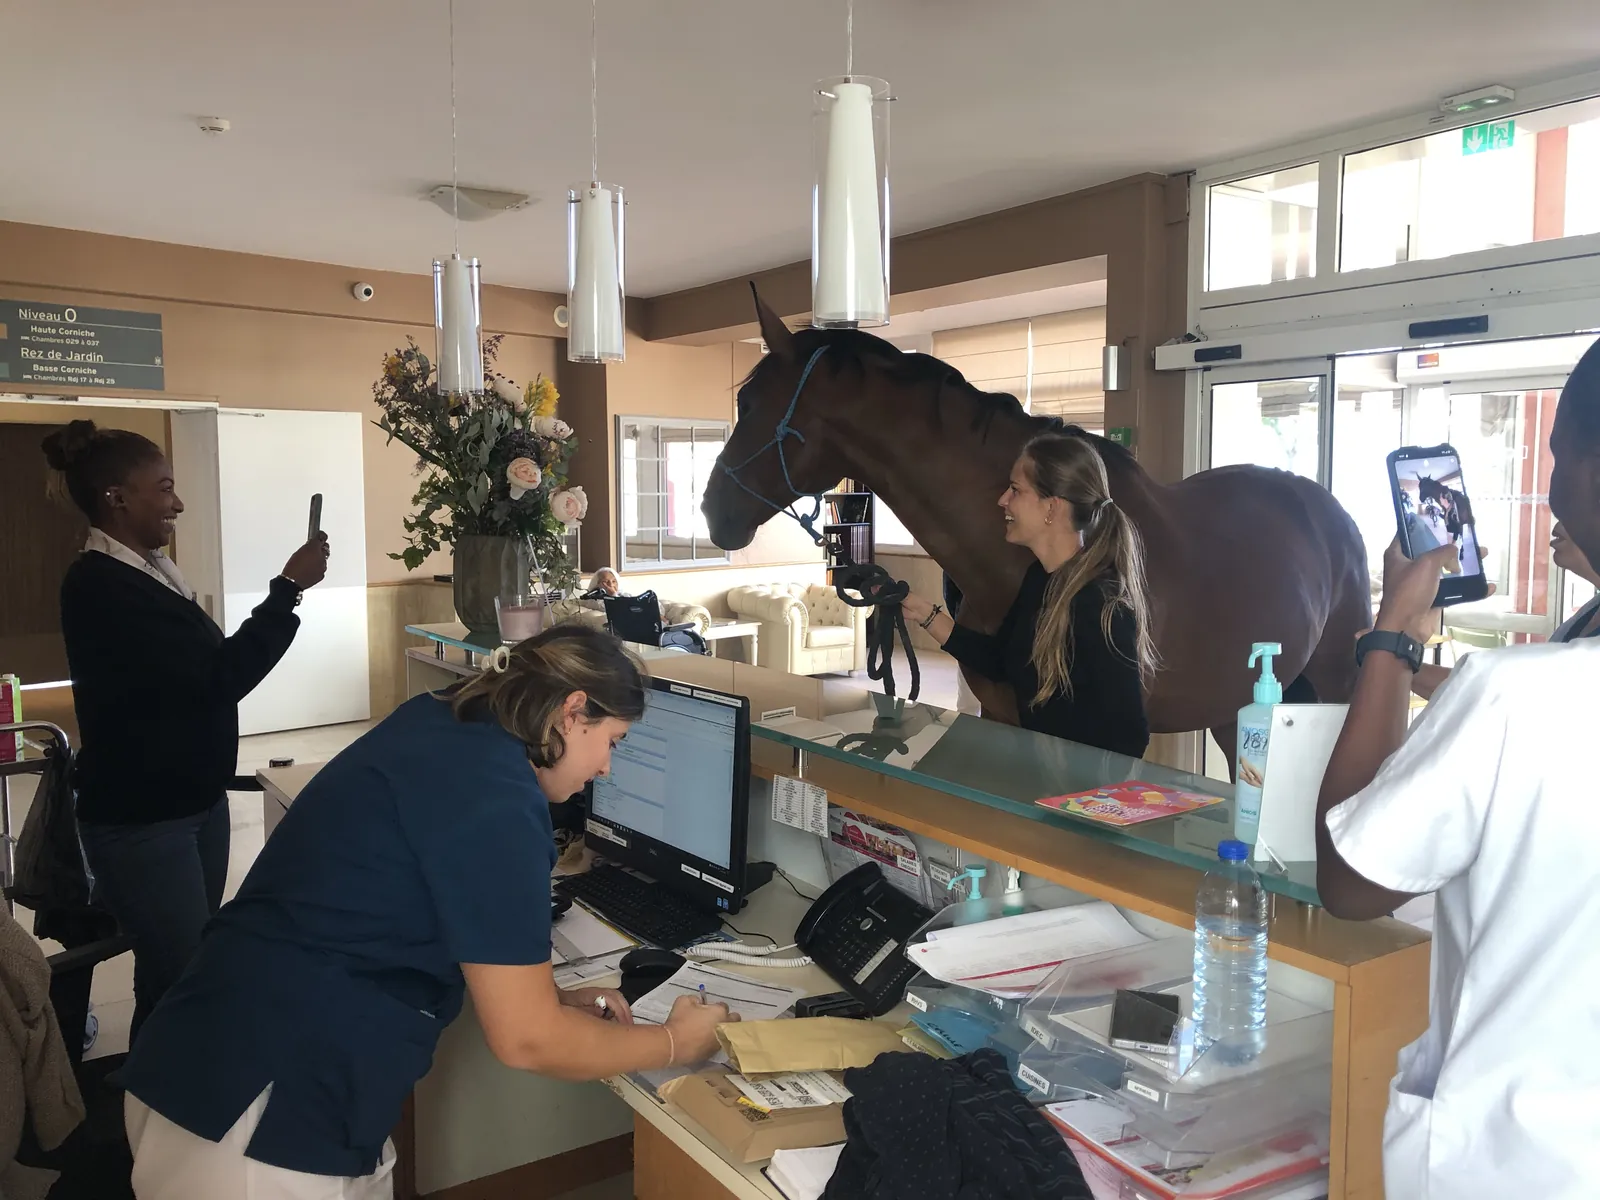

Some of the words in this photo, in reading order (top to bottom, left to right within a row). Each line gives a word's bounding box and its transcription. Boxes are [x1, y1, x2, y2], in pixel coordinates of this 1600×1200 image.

[18, 308, 61, 322] Niveau
[30, 325, 57, 335] Haute
[58, 327, 96, 338] Corniche
[31, 335, 65, 345] Chambres
[20, 347, 44, 359] Rez
[47, 349, 62, 360] de
[66, 351, 104, 362] Jardin
[32, 363, 59, 373] Basse
[60, 365, 98, 376] Corniche
[33, 374, 66, 382] Chambres
[1021, 1069, 1046, 1090] CUISINES
